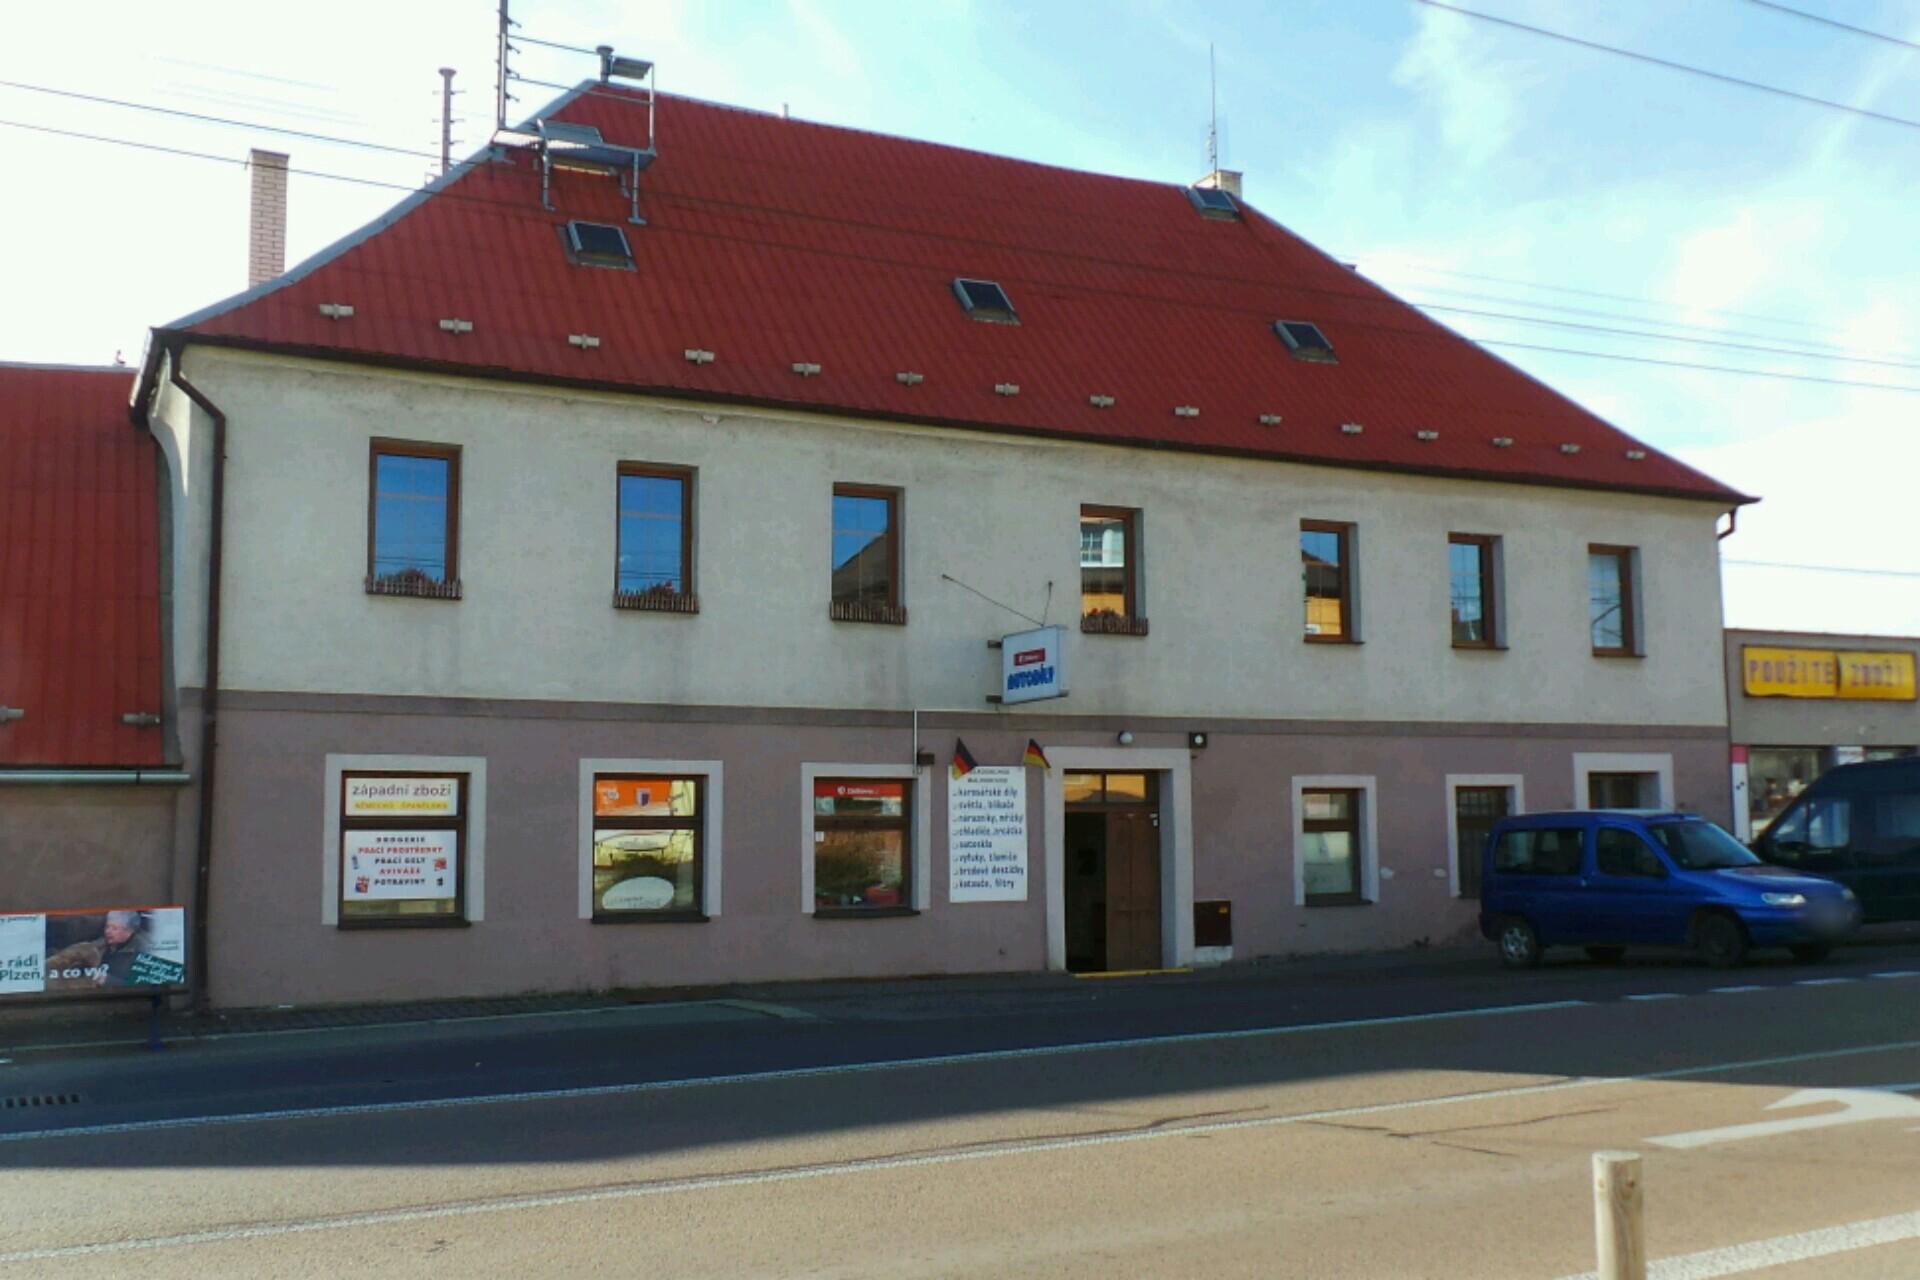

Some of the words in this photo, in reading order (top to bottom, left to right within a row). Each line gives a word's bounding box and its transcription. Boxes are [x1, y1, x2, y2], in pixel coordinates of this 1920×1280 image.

[49, 968, 59, 979] a
[62, 967, 81, 979] co
[84, 963, 110, 981] vy?
